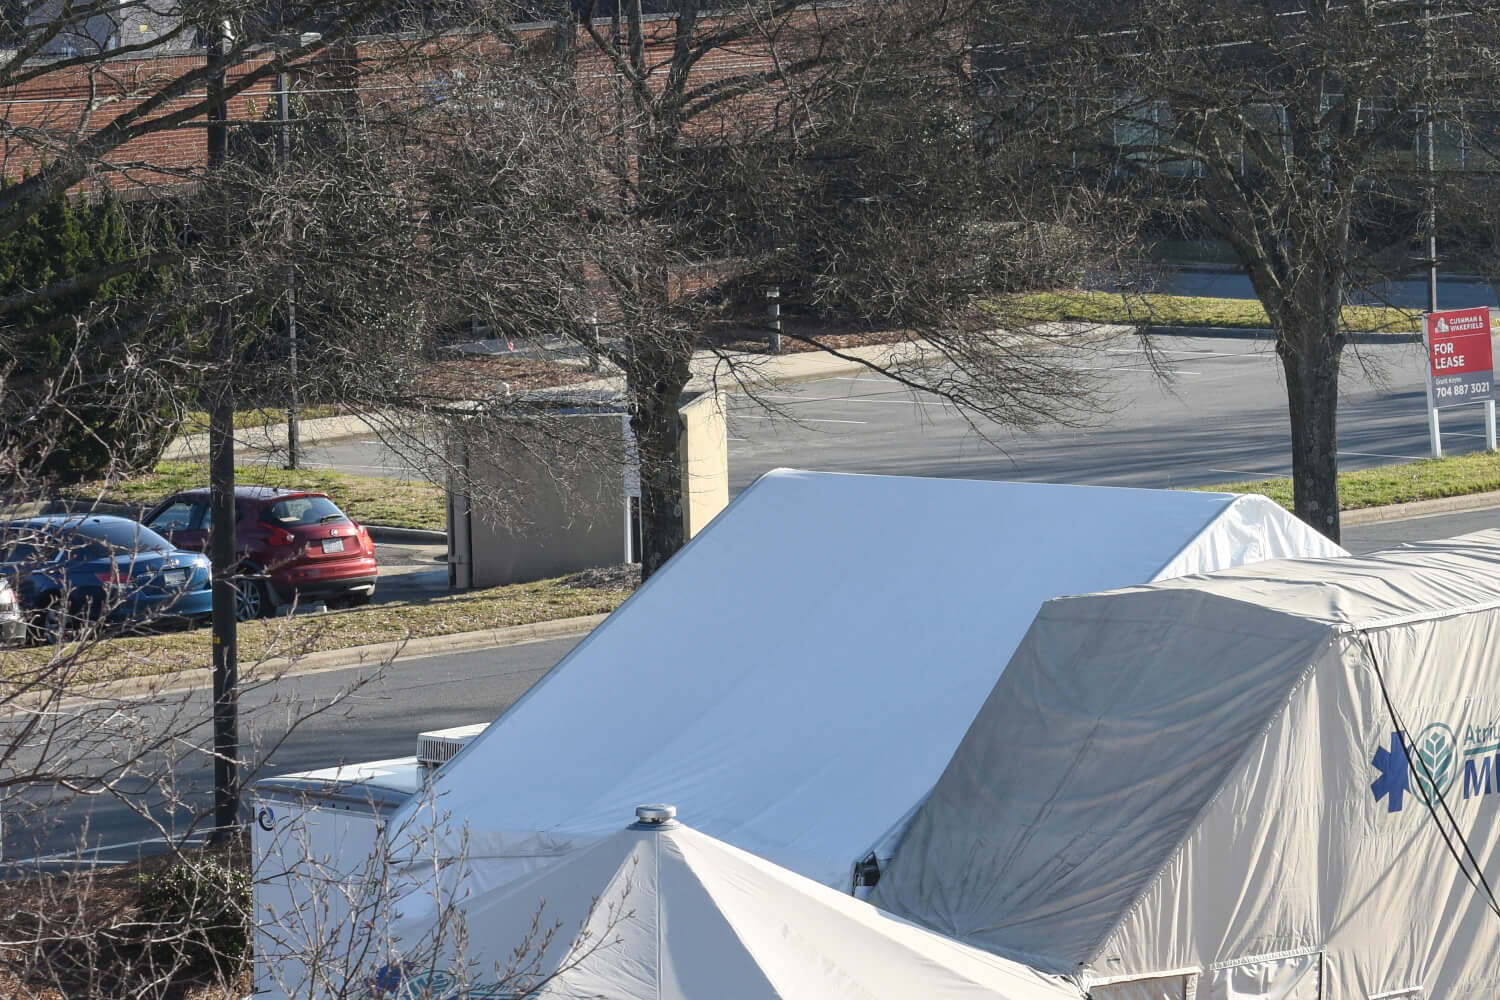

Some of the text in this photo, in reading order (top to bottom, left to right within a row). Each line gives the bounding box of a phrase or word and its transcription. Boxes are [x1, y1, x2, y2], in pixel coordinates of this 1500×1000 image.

[1450, 316, 1478, 325] CUSHMAN
[1450, 322, 1484, 332] WAKEFIELD
[1434, 342, 1454, 355] FOR
[1435, 355, 1465, 369] LEASE
[1436, 382, 1490, 398] 704 887 3021
